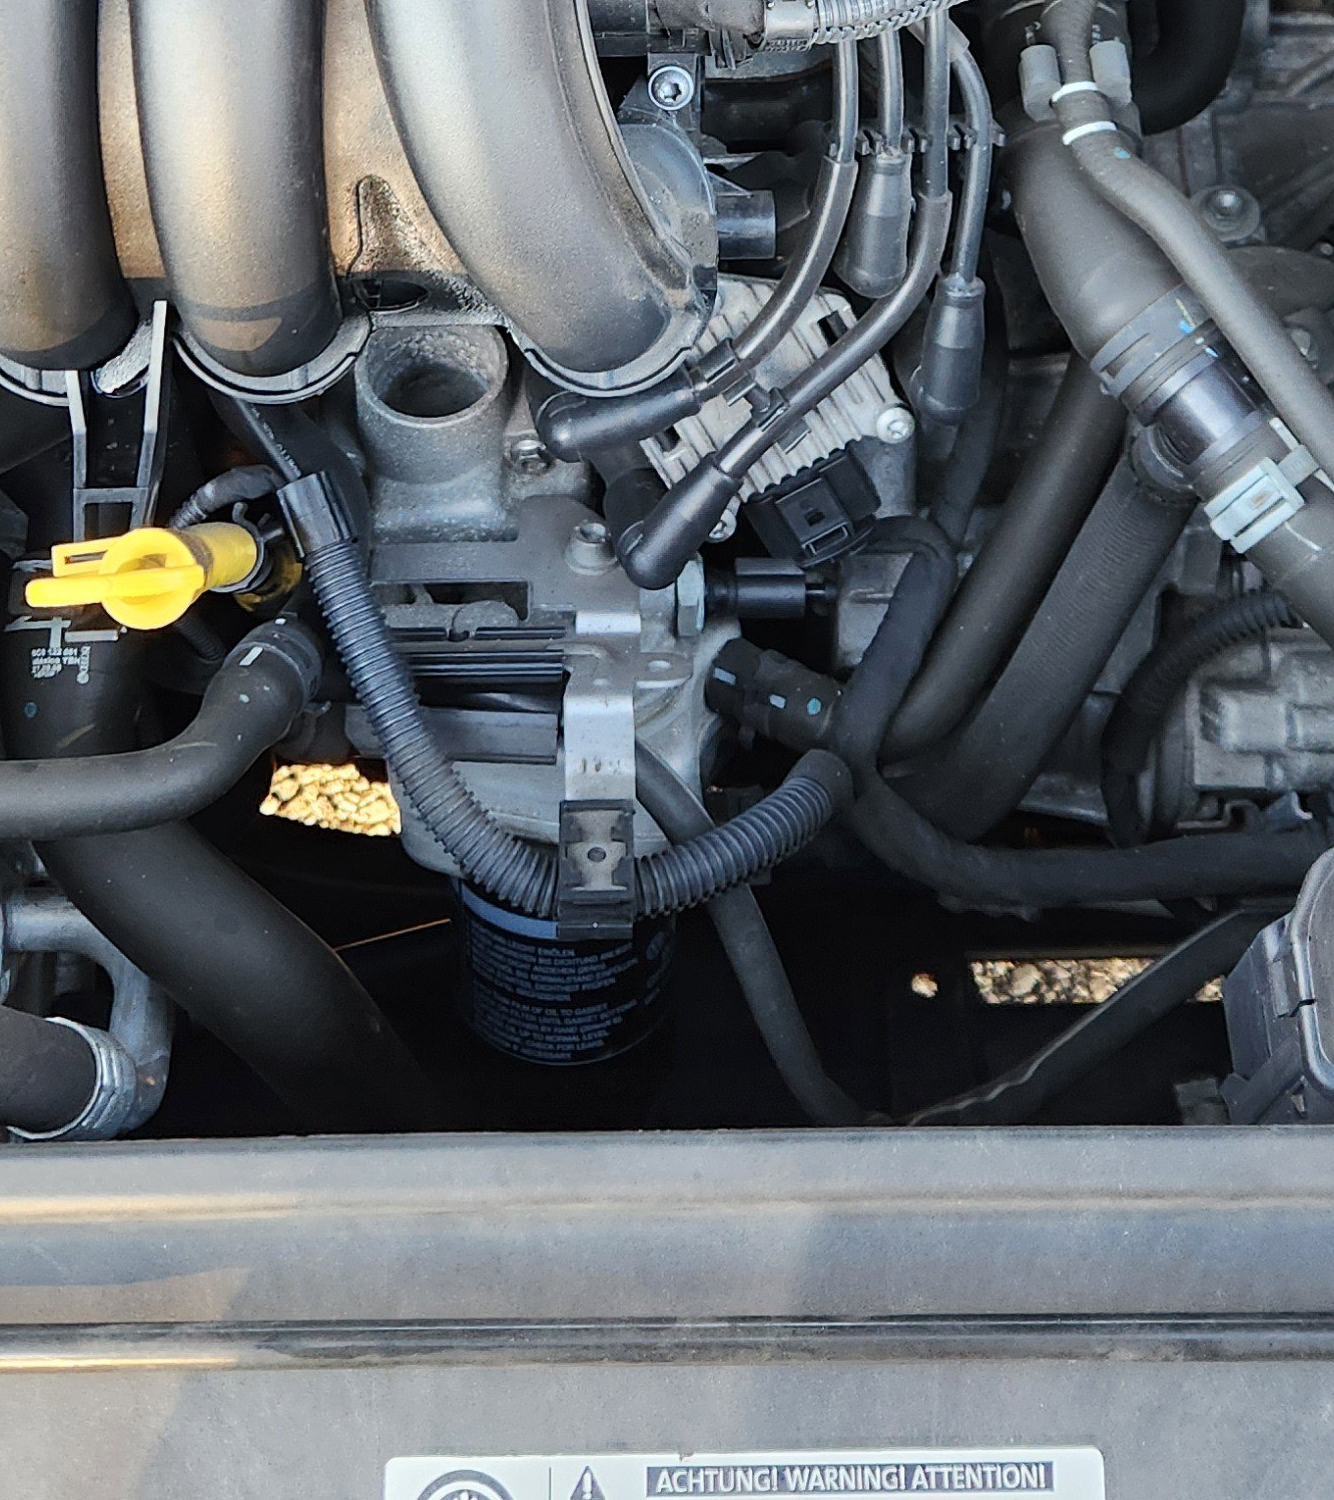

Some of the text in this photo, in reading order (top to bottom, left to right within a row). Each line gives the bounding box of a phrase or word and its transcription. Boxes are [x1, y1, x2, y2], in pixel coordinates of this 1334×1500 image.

[655, 1462, 1046, 1494] ACHTUNG! WARNING! ATTENTION!
